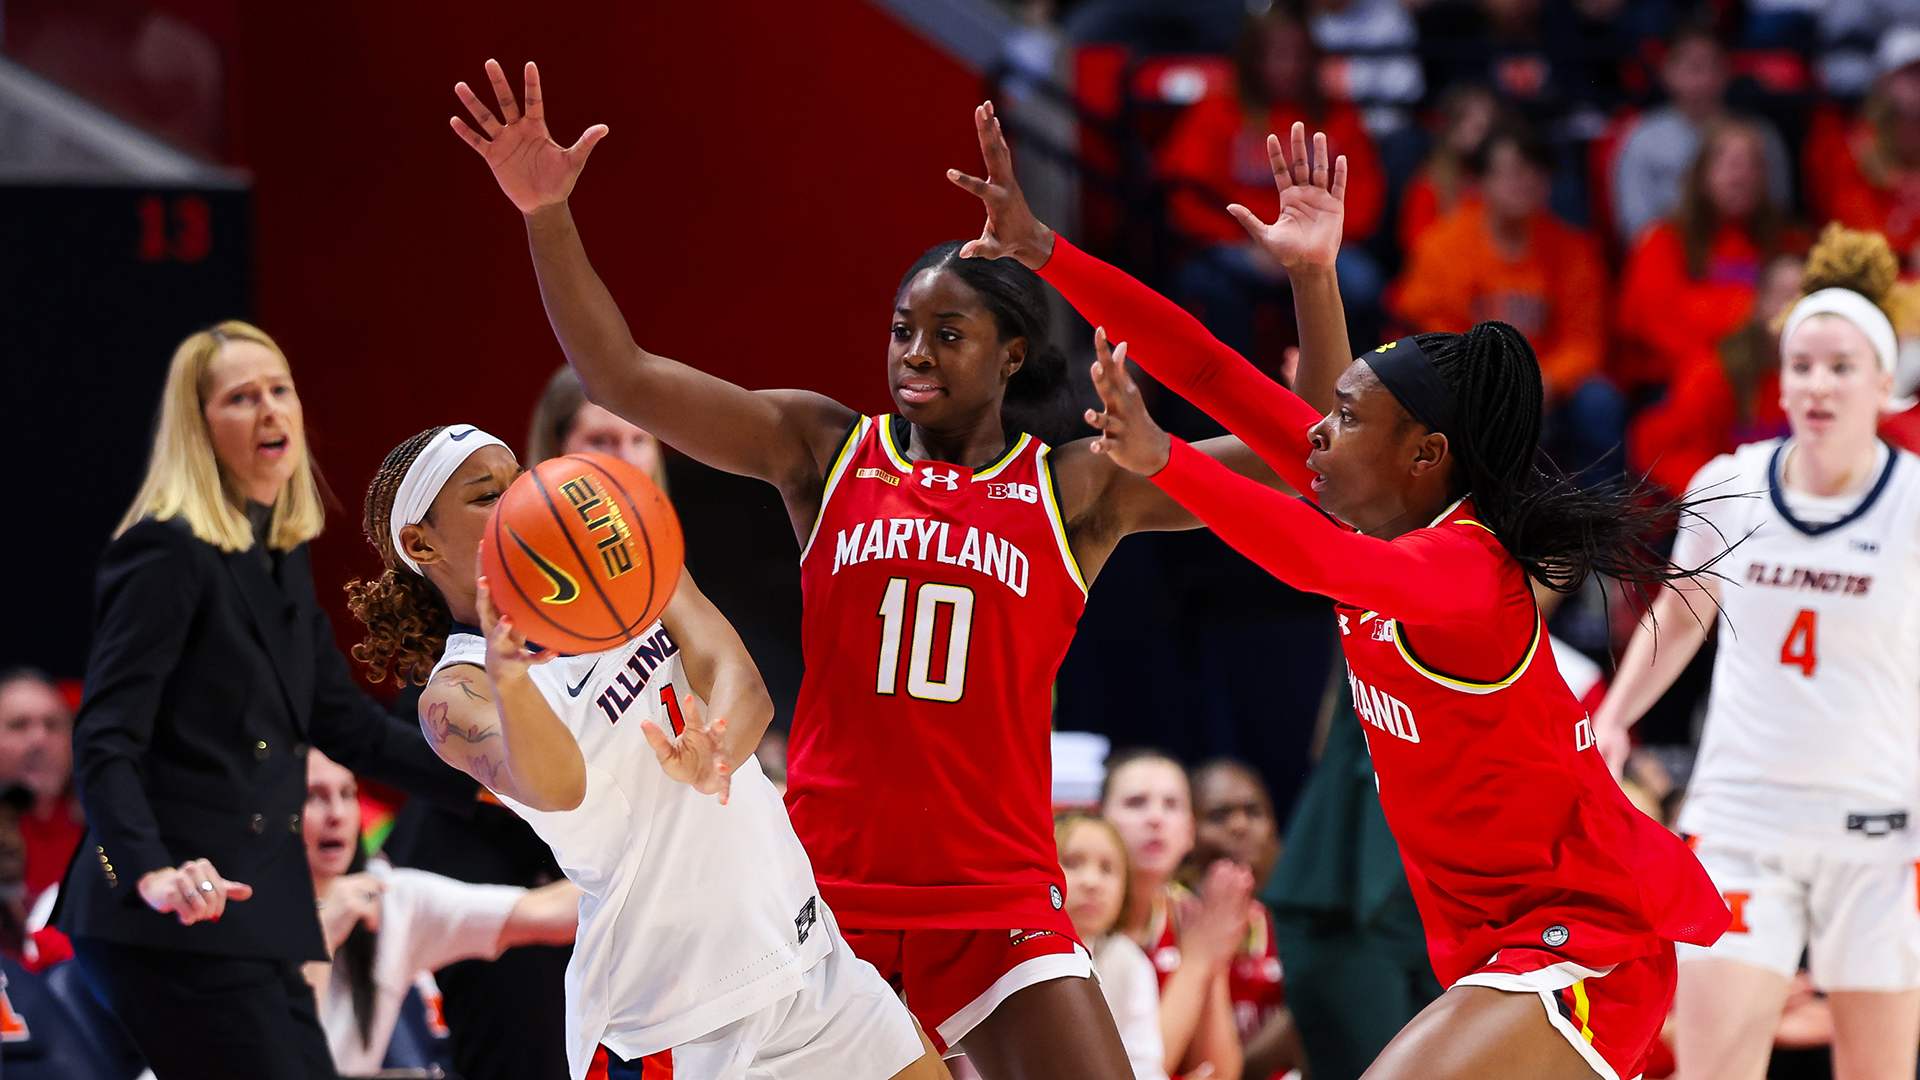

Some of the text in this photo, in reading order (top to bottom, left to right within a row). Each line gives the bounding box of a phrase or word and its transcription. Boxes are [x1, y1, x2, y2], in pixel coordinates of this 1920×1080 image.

[139, 197, 211, 261] 13
[559, 476, 633, 579] ELITE
[832, 518, 1030, 598] MARYLAND
[1748, 563, 1873, 596] ILLINOIS
[876, 576, 976, 703] 10
[1781, 610, 1816, 677] 4
[659, 683, 685, 738] 1
